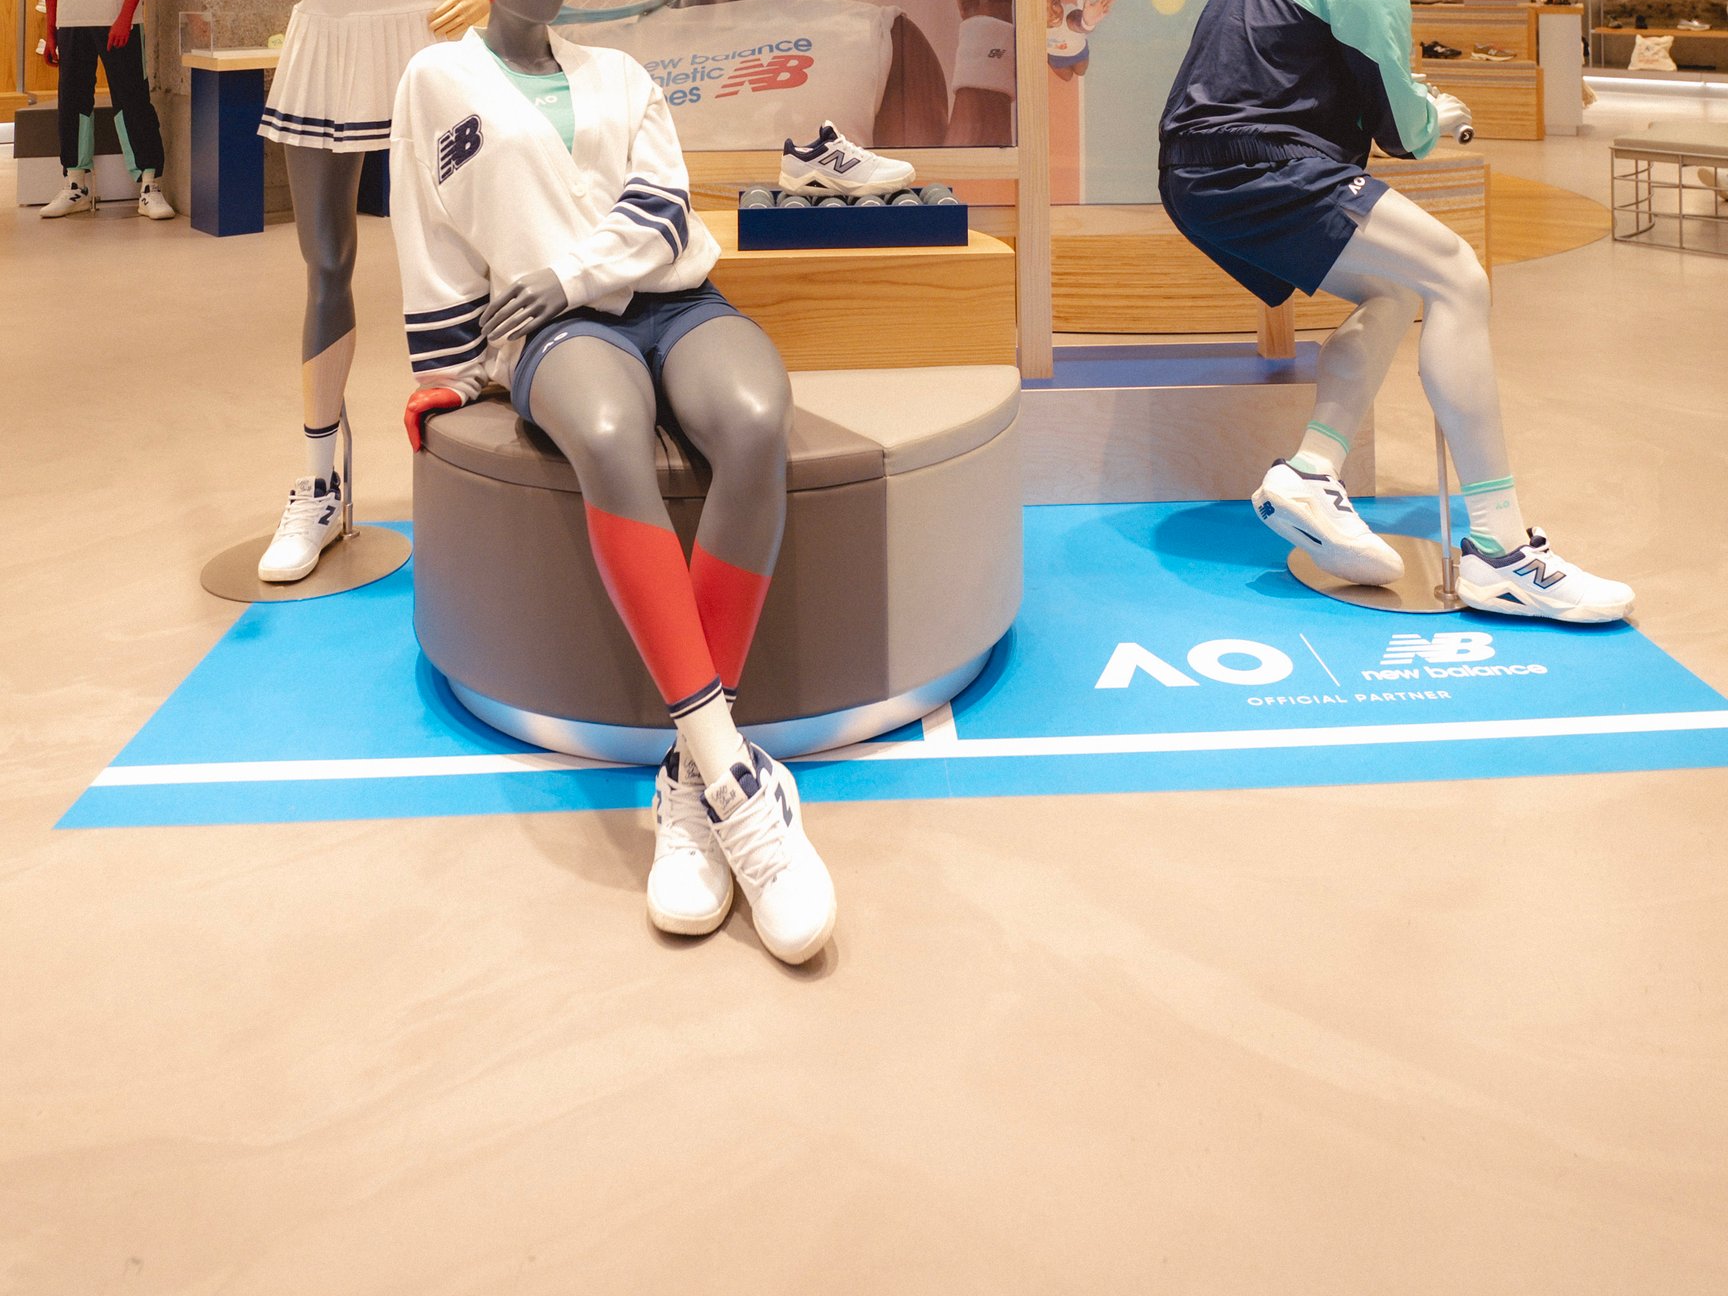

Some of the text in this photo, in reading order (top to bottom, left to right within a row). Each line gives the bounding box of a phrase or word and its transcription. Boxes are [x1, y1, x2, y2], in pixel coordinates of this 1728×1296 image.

[644, 38, 813, 72] ew balance
[651, 66, 725, 88] hletic
[664, 86, 702, 106] es
[1348, 176, 1366, 195] AO
[1379, 631, 1496, 665] NB
[1094, 638, 1294, 689] AO
[1360, 663, 1548, 681] new balance
[1247, 690, 1452, 706] OFFICIAL PARTNER
